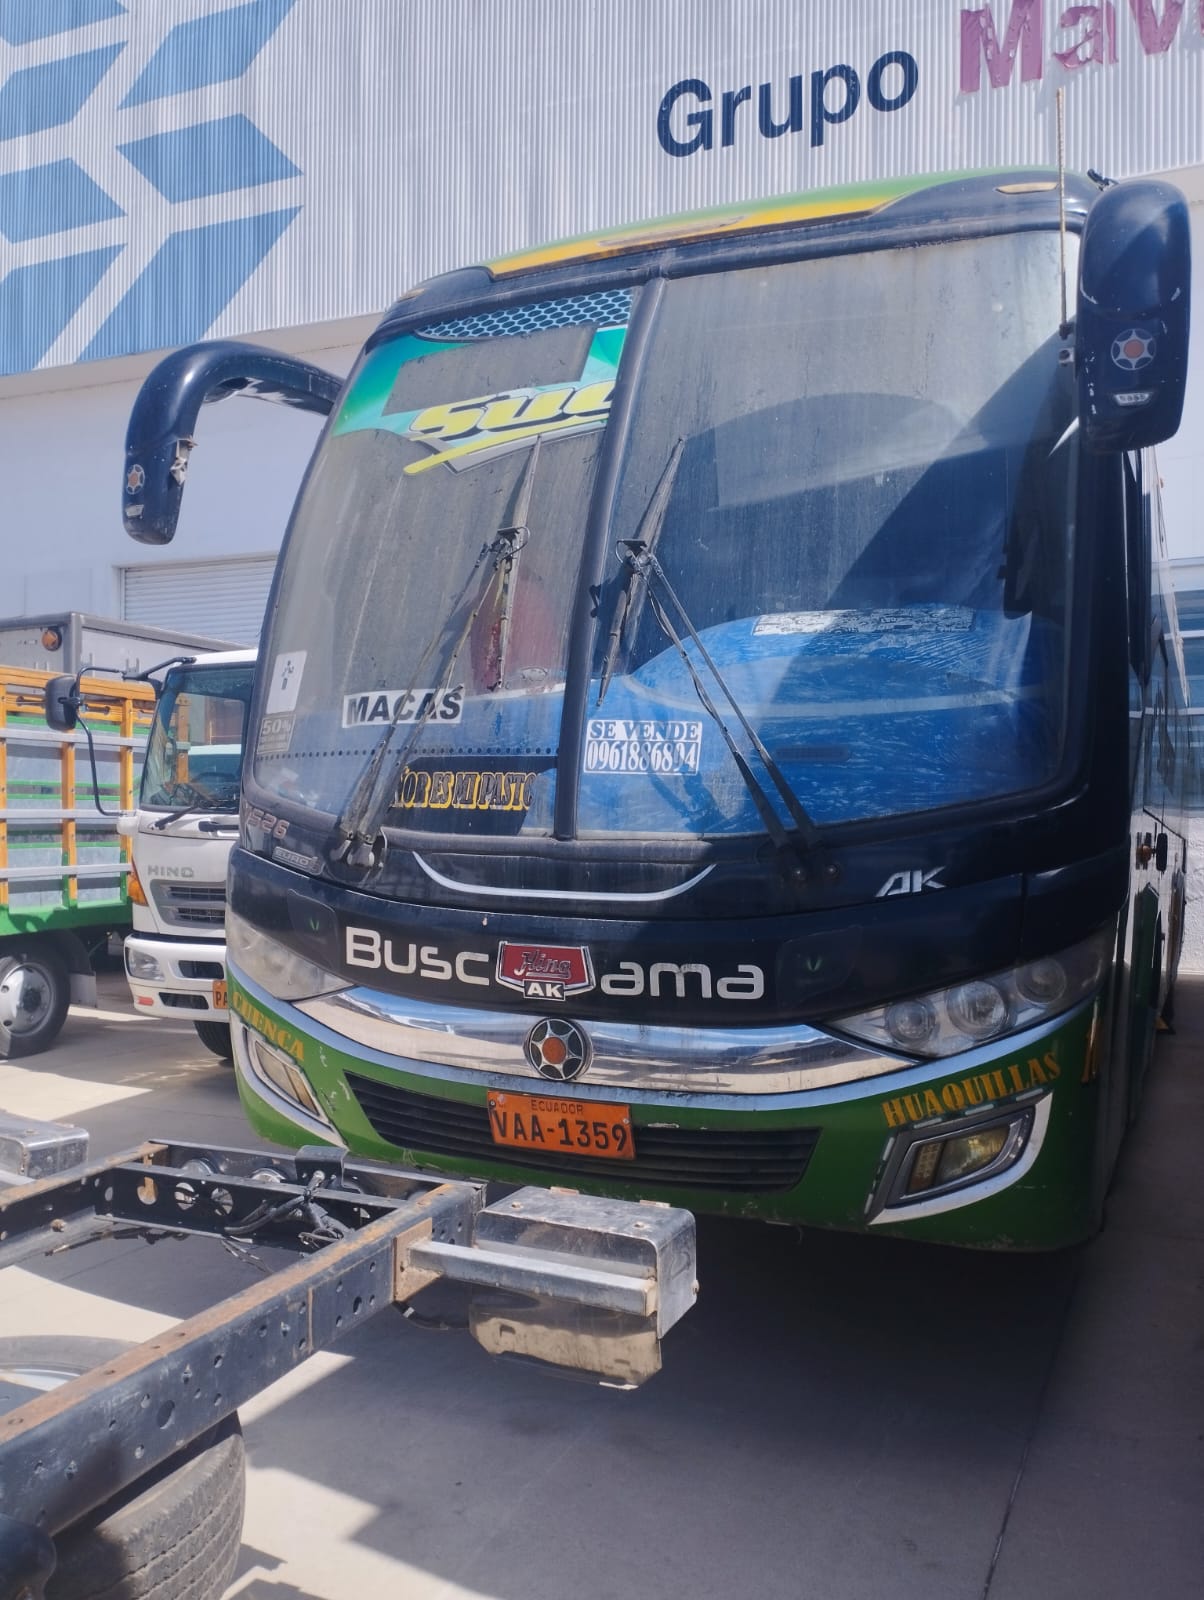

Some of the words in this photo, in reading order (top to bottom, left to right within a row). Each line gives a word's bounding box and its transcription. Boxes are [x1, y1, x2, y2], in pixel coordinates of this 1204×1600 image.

[656, 50, 919, 158] Grupo
[960, 0, 1204, 94] Mav
[346, 692, 462, 725] MACAS
[590, 721, 617, 739] SE
[622, 721, 699, 741] VENDE
[147, 864, 194, 878] HINO
[875, 866, 947, 898] AK
[527, 982, 562, 998] AK
[233, 991, 304, 1062] CUENCA
[881, 1051, 1062, 1128] HUAQUILLAS
[531, 1100, 584, 1114] ECUADOR
[492, 1110, 628, 1152] VAA-1359
